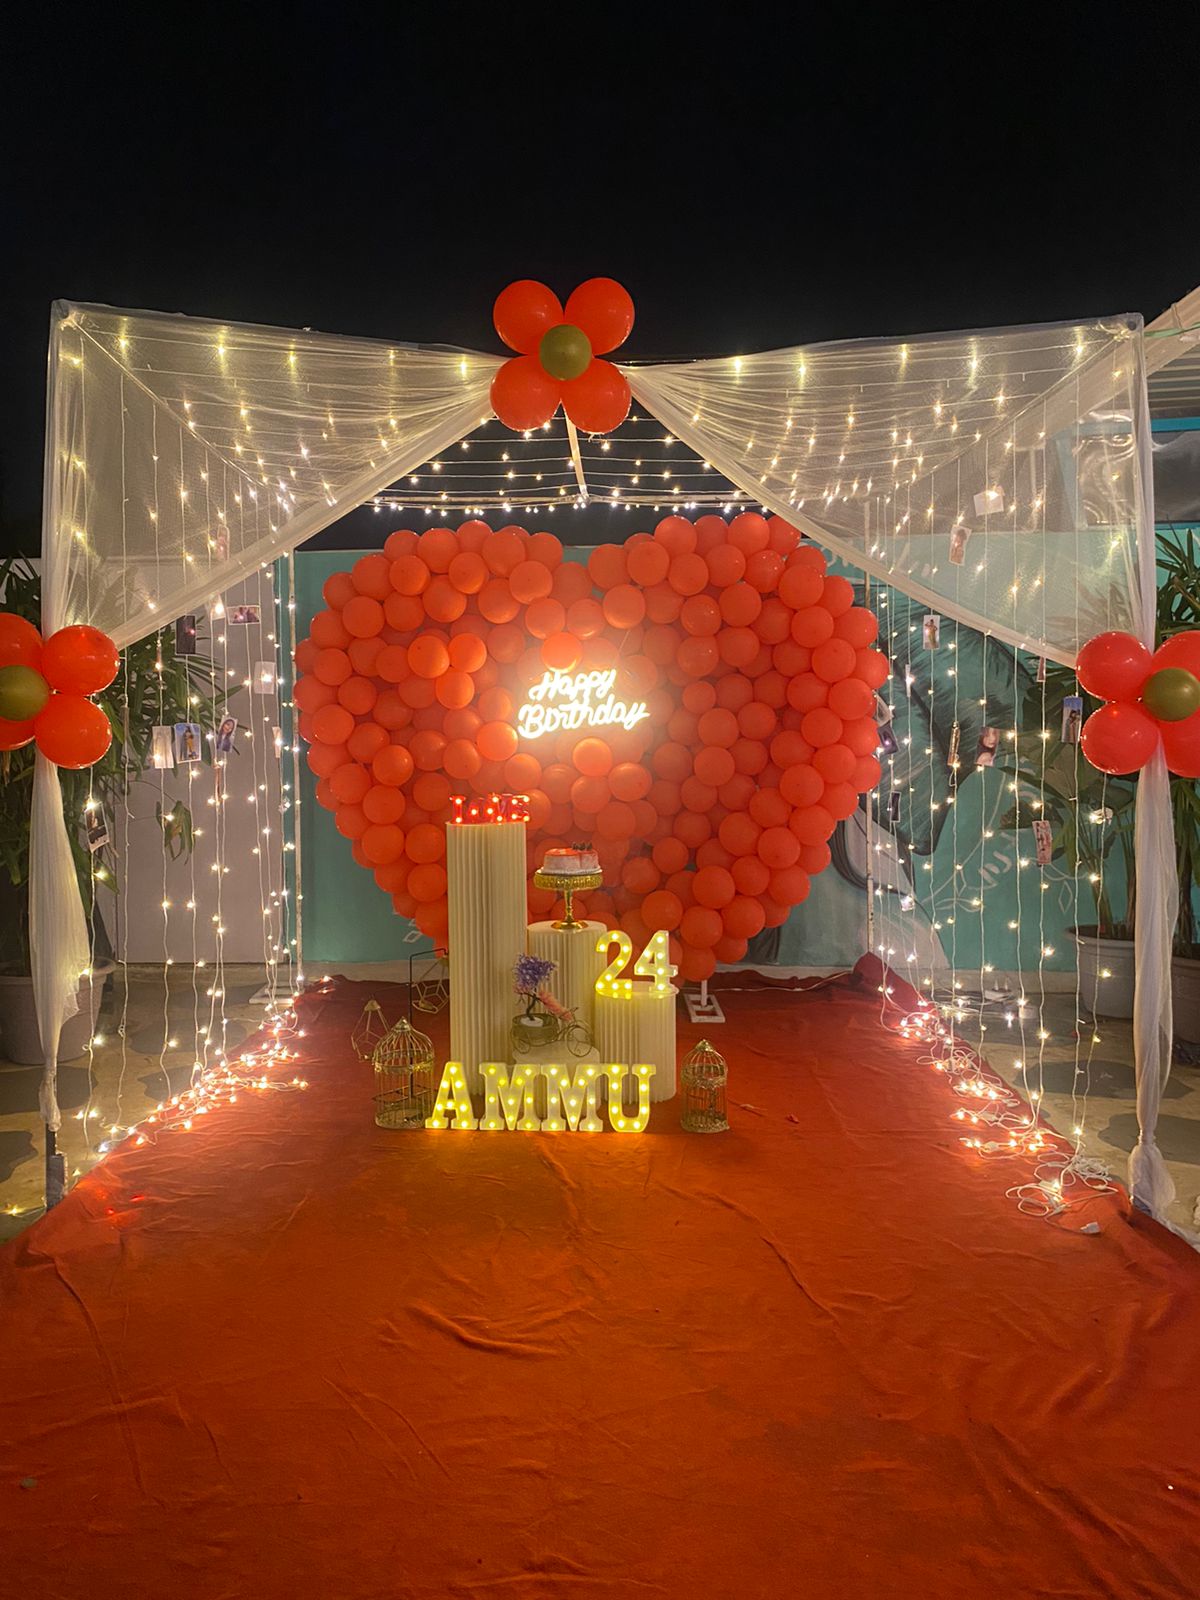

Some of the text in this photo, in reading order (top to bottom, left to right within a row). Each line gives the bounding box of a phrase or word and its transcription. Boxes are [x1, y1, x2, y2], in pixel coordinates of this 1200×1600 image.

[528, 668, 617, 704] Happy
[518, 694, 650, 739] Birthday
[595, 929, 679, 993] 24
[425, 1061, 657, 1133] AMMU
